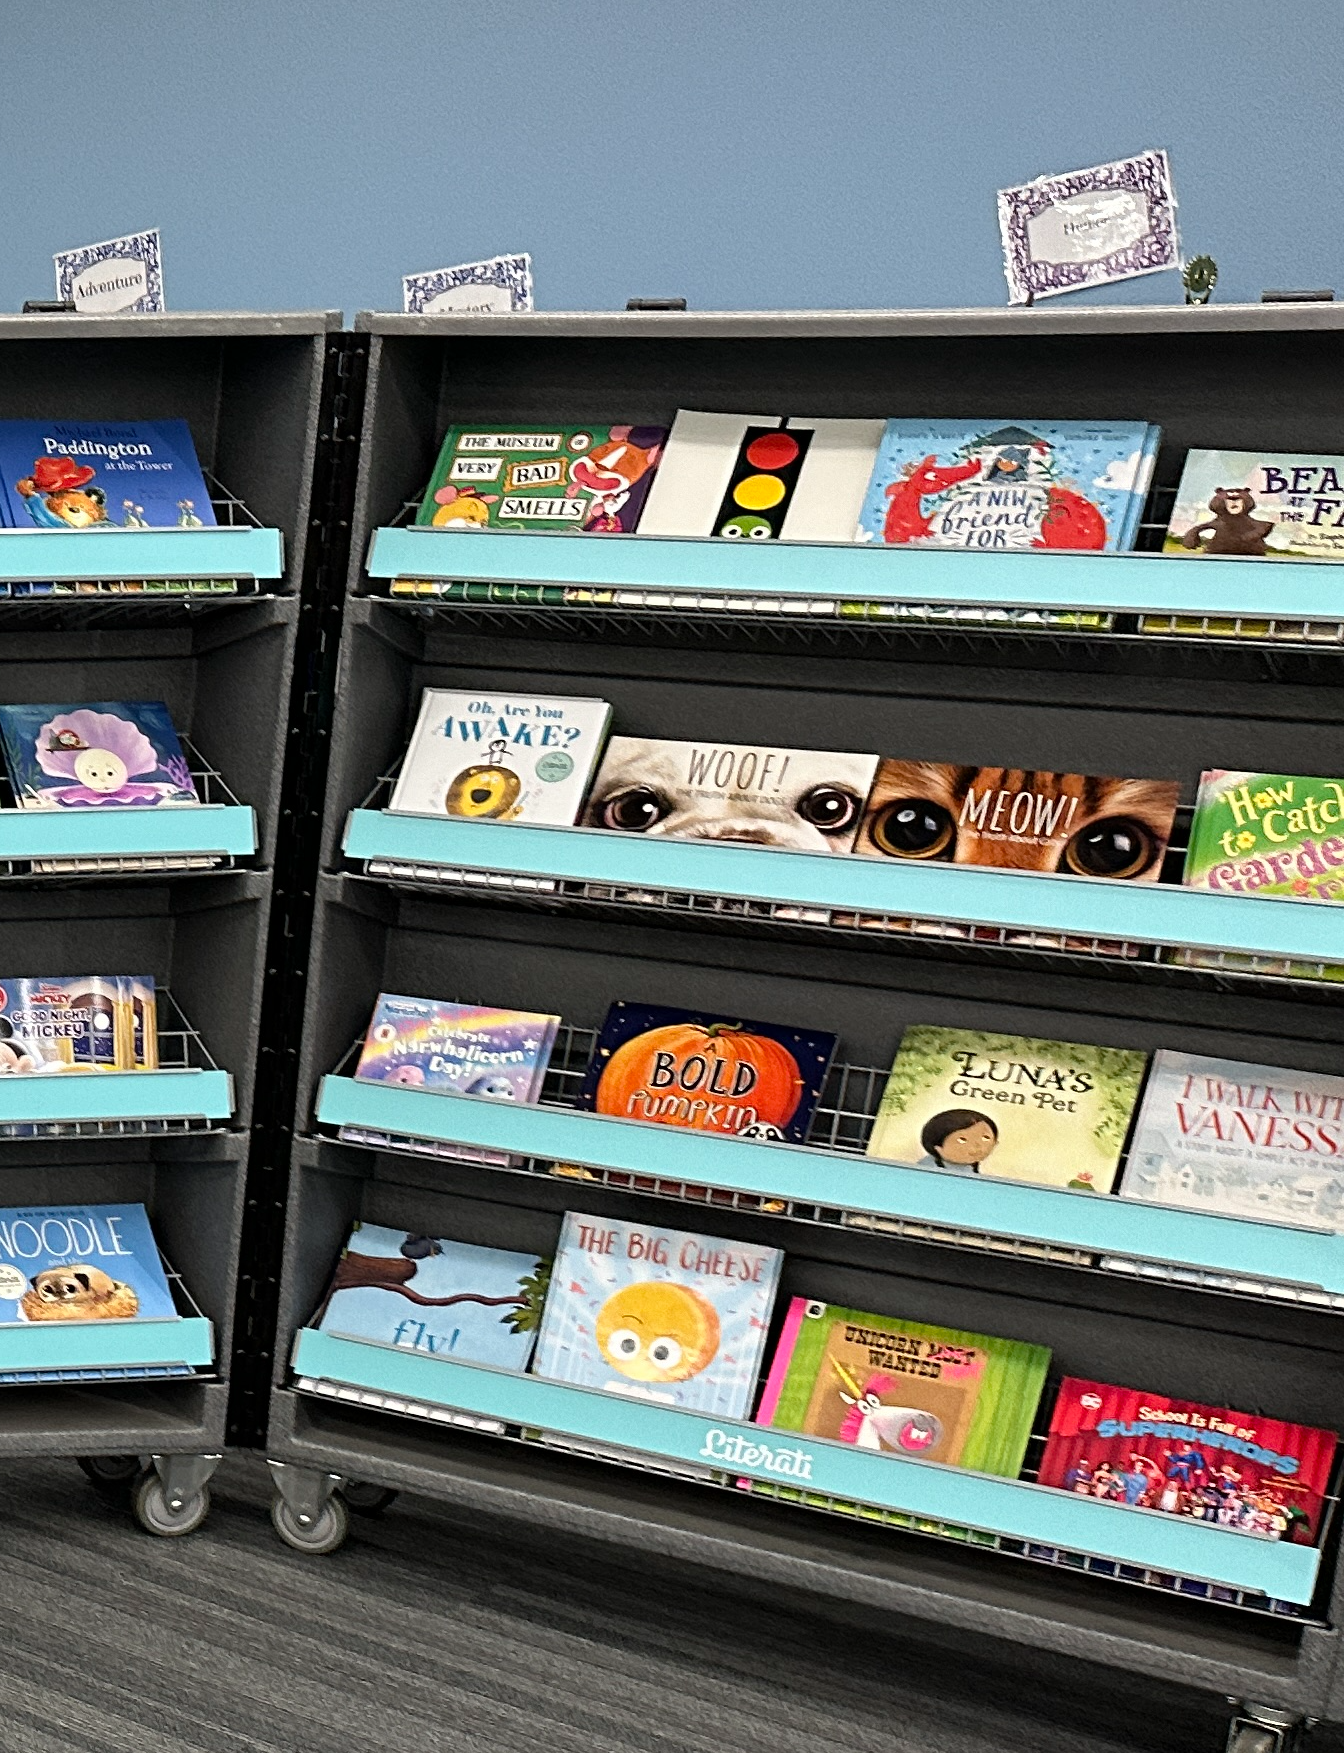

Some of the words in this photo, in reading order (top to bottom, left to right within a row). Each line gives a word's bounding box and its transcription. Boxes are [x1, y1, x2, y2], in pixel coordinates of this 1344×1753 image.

[75, 274, 142, 299] Adventure
[43, 438, 152, 460] Paddington
[464, 437, 492, 449] THE
[495, 438, 556, 449] MUSEUM
[118, 460, 136, 471] the
[138, 460, 173, 472] Tower
[456, 461, 496, 476] VERY
[516, 464, 556, 485] BAD
[502, 499, 584, 517] SMELLS
[967, 490, 979, 505] A
[985, 491, 1028, 507] NEW
[941, 509, 1035, 537] friend
[965, 531, 1005, 547] FOR
[431, 716, 582, 749] AWAKE?
[687, 748, 791, 793] WOOF!
[958, 788, 1079, 838] MEOW!
[1224, 781, 1295, 828] How
[22, 1022, 85, 1039] MICKEY
[392, 1038, 524, 1065] Narwhalicorn
[429, 1056, 474, 1079] Day!
[650, 1052, 757, 1098] BOLD
[952, 1050, 1094, 1094] LUNA'S
[627, 1089, 758, 1130] PUMPKIN
[949, 1080, 1026, 1106] Green
[1033, 1092, 1077, 1114] Pet
[578, 1224, 621, 1257] THE
[627, 1233, 668, 1268] BIG
[678, 1240, 769, 1284] CHEESE
[844, 1324, 925, 1355] UNICORN
[867, 1349, 943, 1379] WANTED
[700, 1428, 812, 1480] Literati
